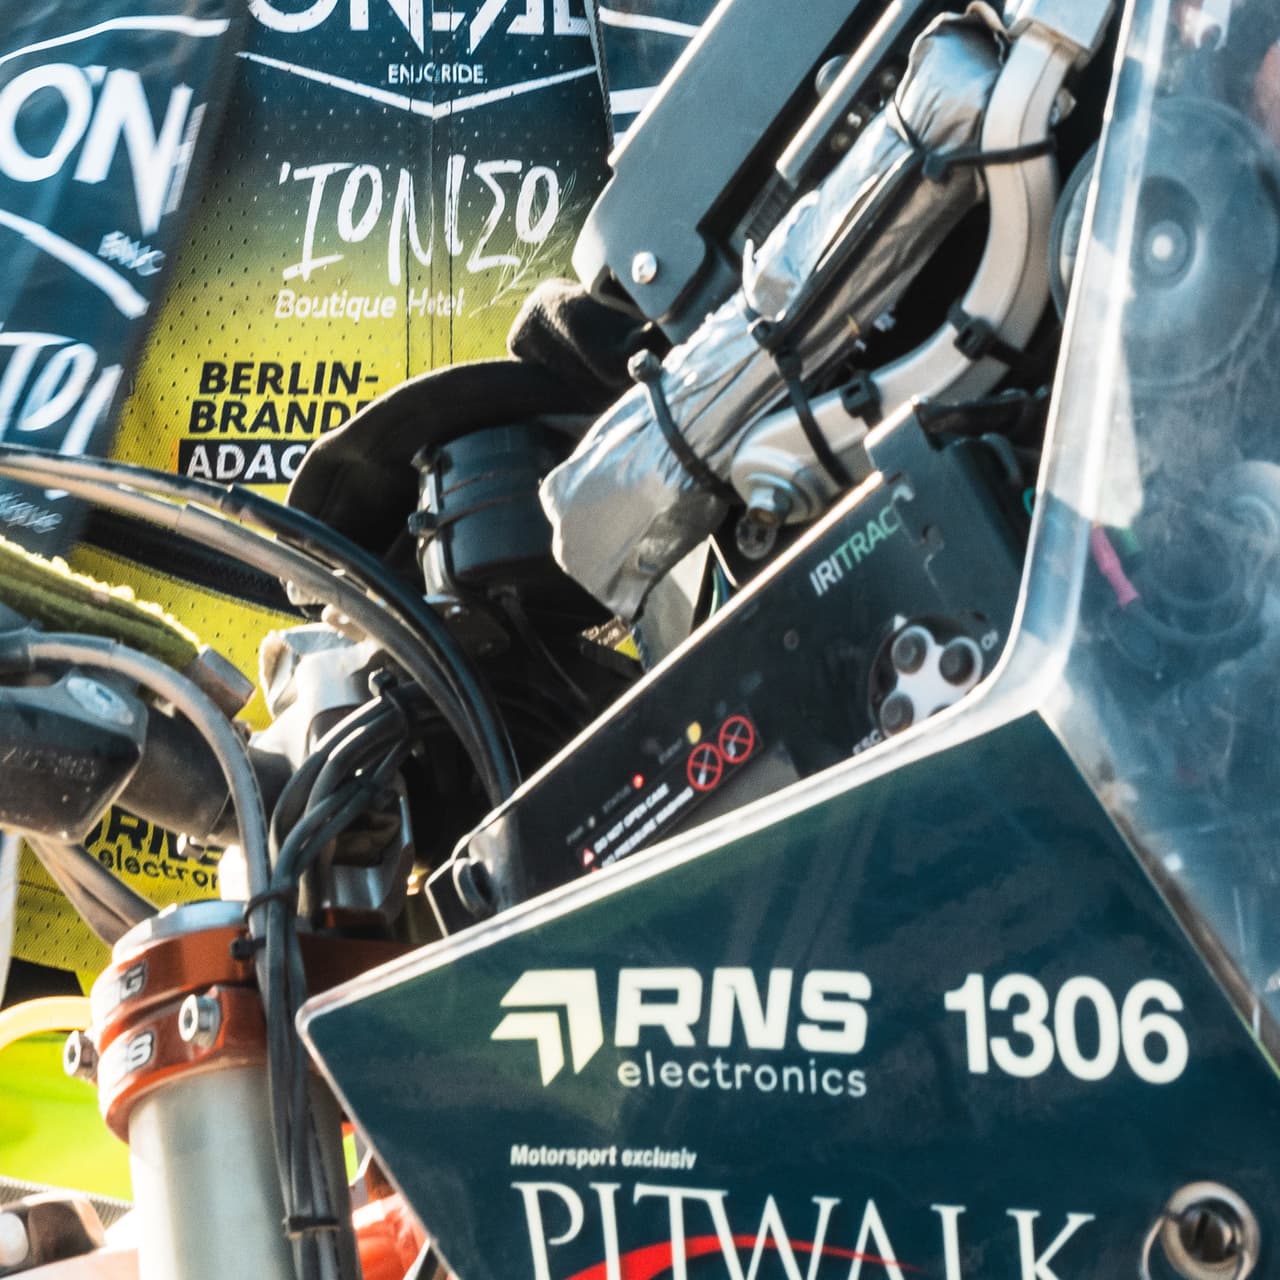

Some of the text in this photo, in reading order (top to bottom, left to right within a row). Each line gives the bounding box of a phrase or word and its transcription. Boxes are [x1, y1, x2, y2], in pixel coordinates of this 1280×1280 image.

[274, 289, 397, 321] Boutique
[199, 360, 379, 396] BERLIN-
[809, 504, 902, 597] IRITRAC
[614, 967, 1190, 1085] RNS 1306
[617, 1050, 868, 1097] electronics
[510, 1144, 697, 1170] Motorsport exclusiv
